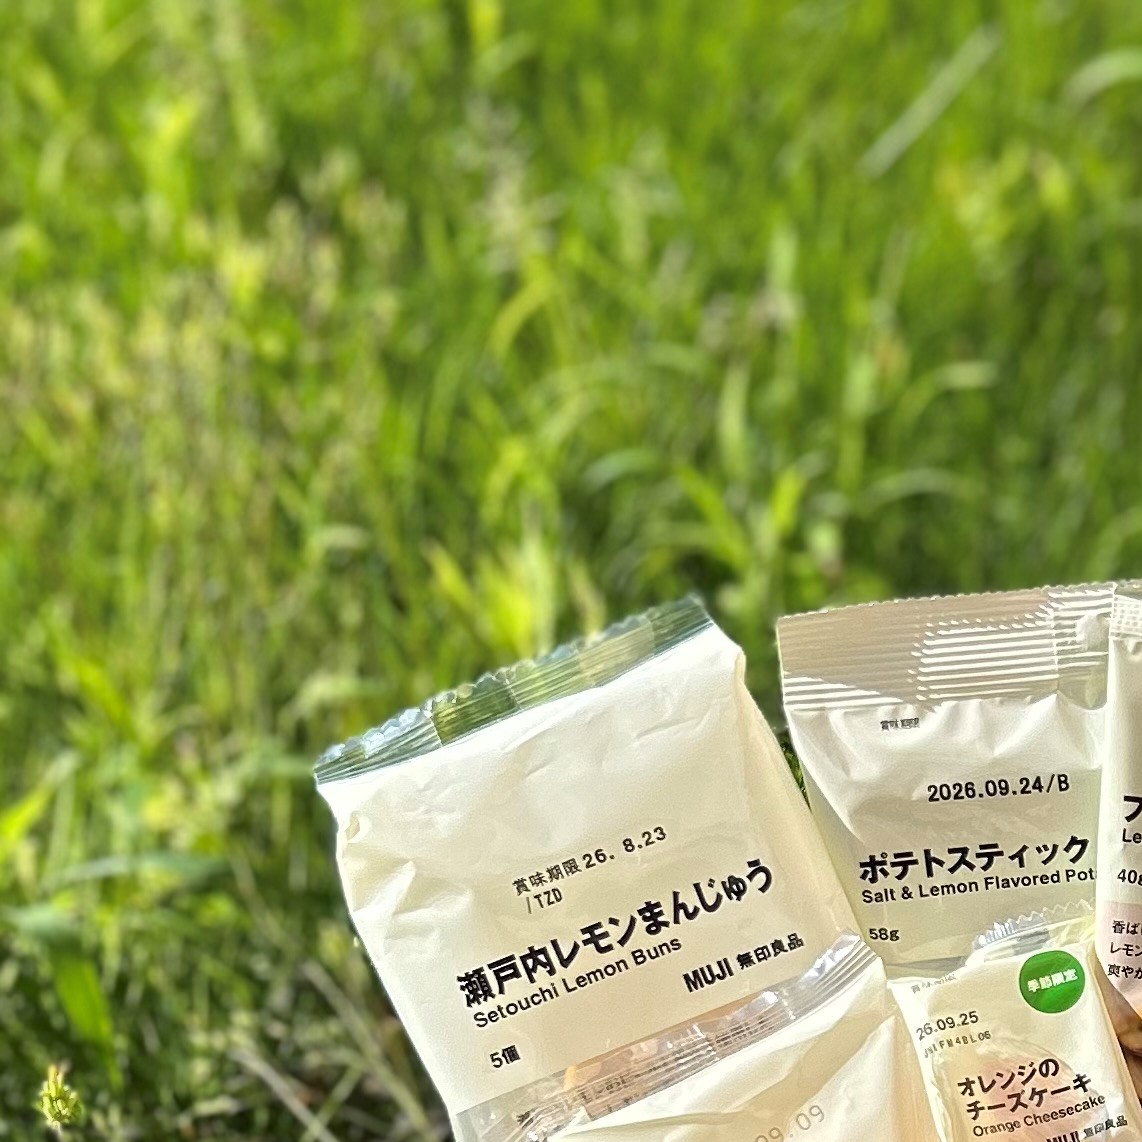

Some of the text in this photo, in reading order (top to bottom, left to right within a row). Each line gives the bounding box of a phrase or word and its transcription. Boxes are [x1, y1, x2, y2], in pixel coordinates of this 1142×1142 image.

[926, 773, 1070, 803] 2026.09.24/B
[511, 857, 582, 896] 賞味期限
[858, 834, 1091, 884] ポテトスティック
[861, 866, 1098, 904] Salt & Lemon Flavored Pot
[456, 858, 774, 1008] 瀬戸内レモンまんじゅう
[868, 926, 900, 944] 58g
[473, 936, 682, 1029] Setouchi Lemon Buns
[683, 932, 804, 993] MUJI 無印良品
[915, 1010, 979, 1042] 26.09.25
[490, 1044, 521, 1070] 5個
[957, 1057, 1060, 1098] オレンジの
[965, 1072, 1092, 1121] チーズケーキ
[972, 1092, 1107, 1139] Orange Cheesecake
[1082, 1114, 1129, 1141] 無印良品
